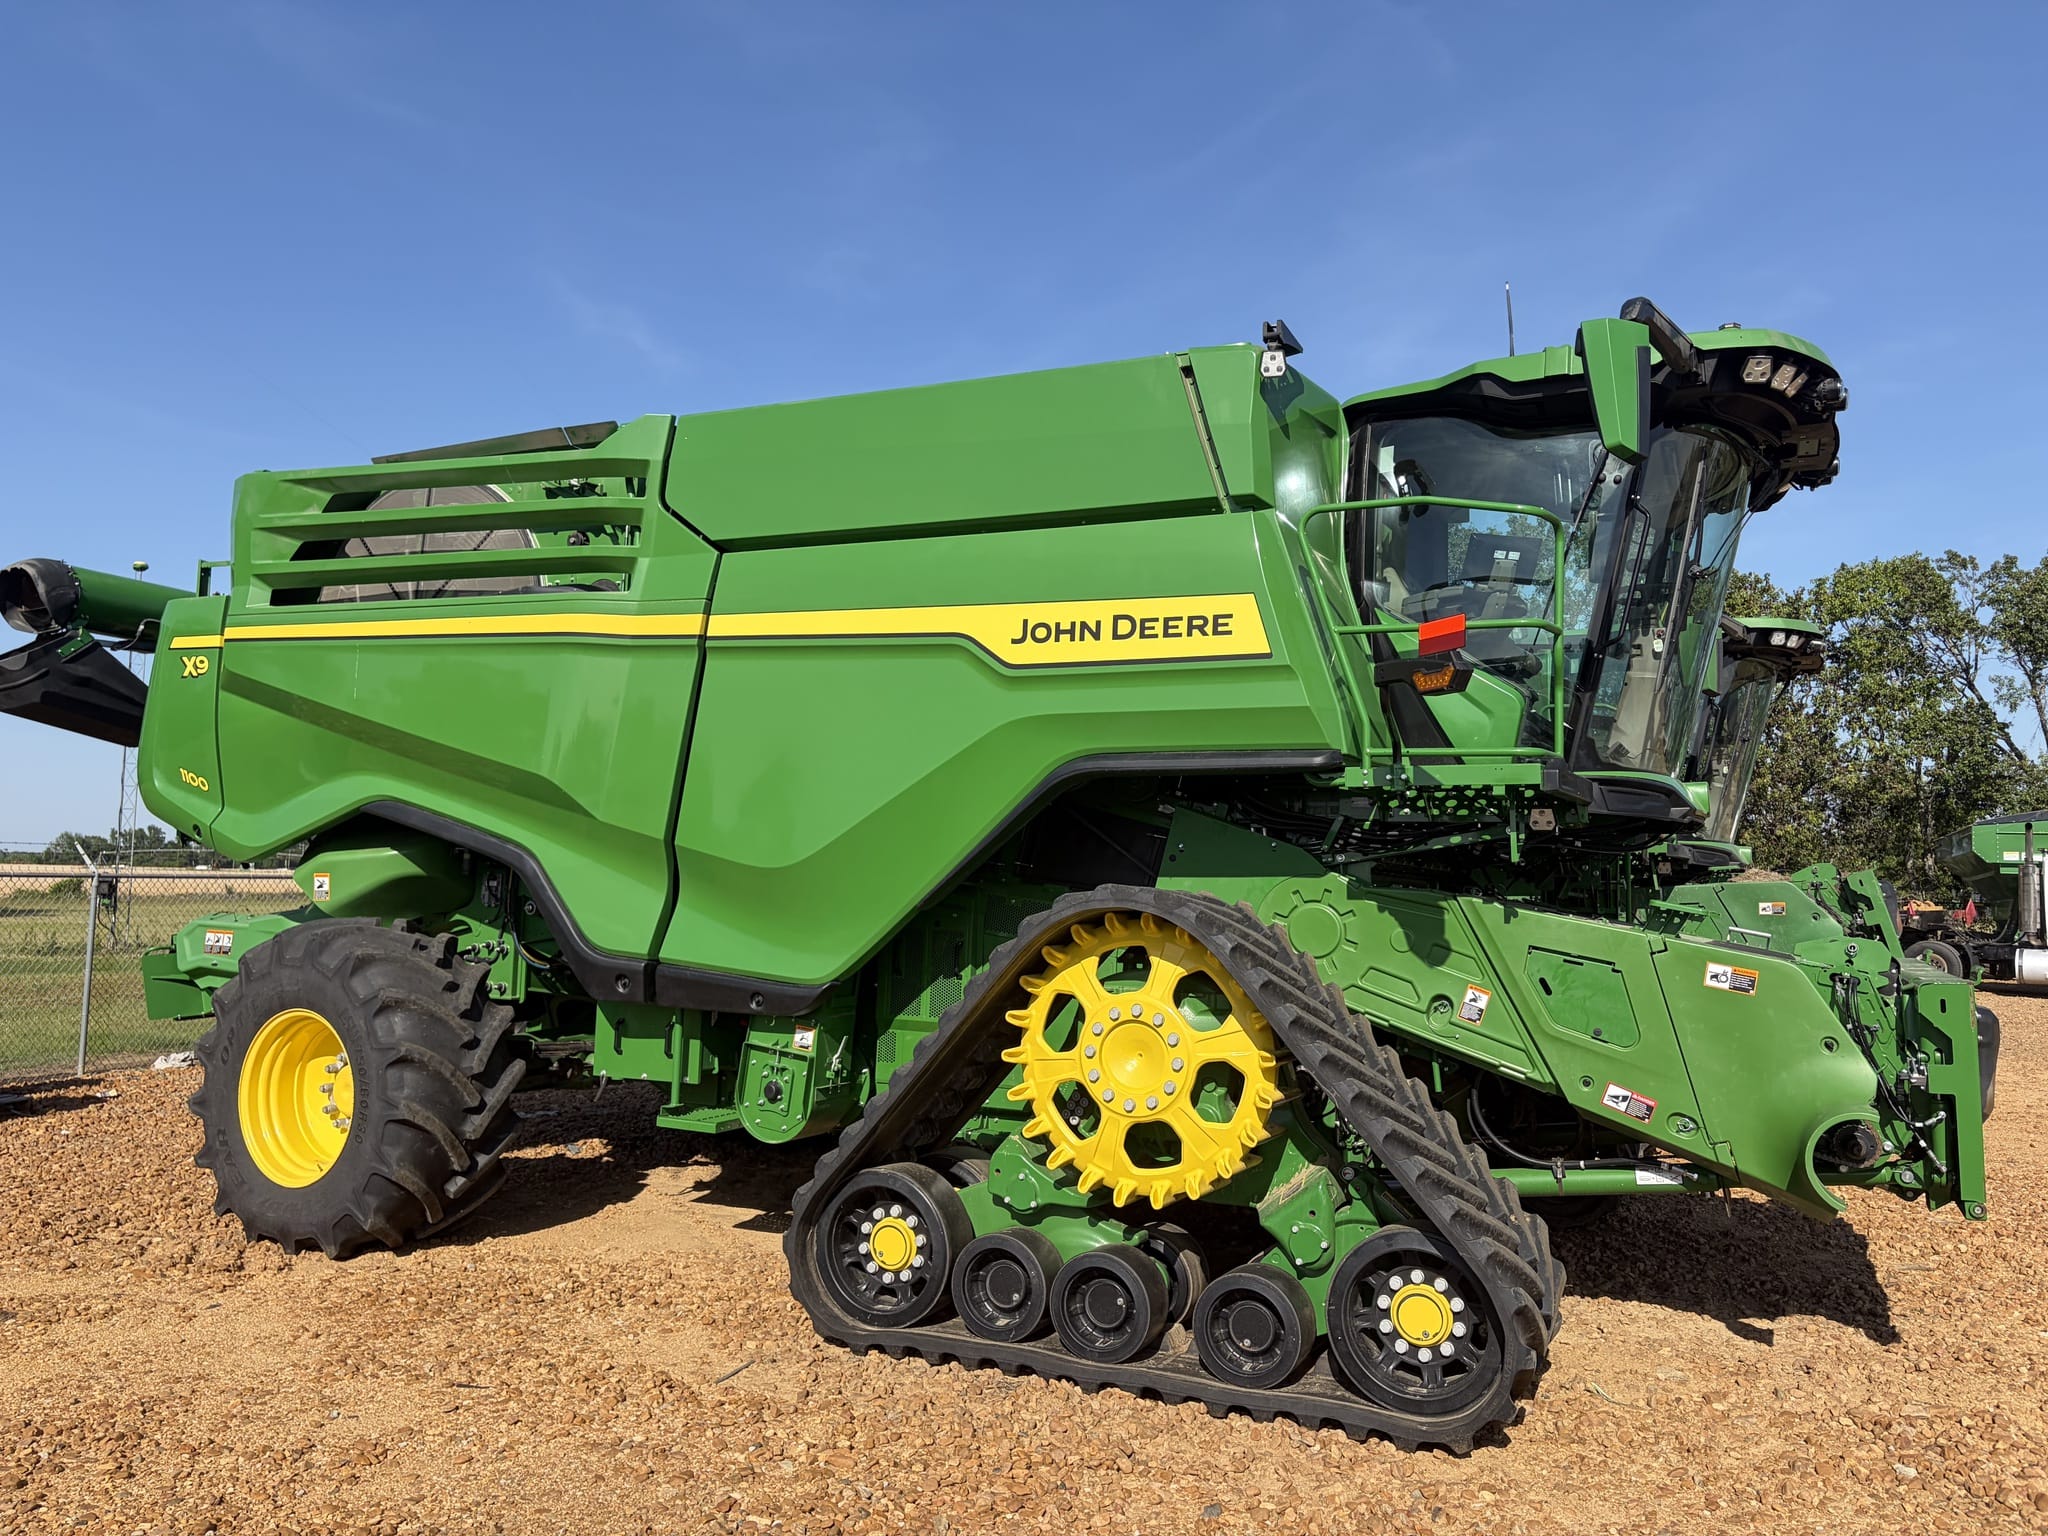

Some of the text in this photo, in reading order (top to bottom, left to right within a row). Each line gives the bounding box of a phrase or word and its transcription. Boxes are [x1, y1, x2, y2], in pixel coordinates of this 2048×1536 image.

[1010, 613, 1234, 645] JOHN DEERE
[180, 655, 209, 679] X9
[179, 767, 209, 792] 1100
